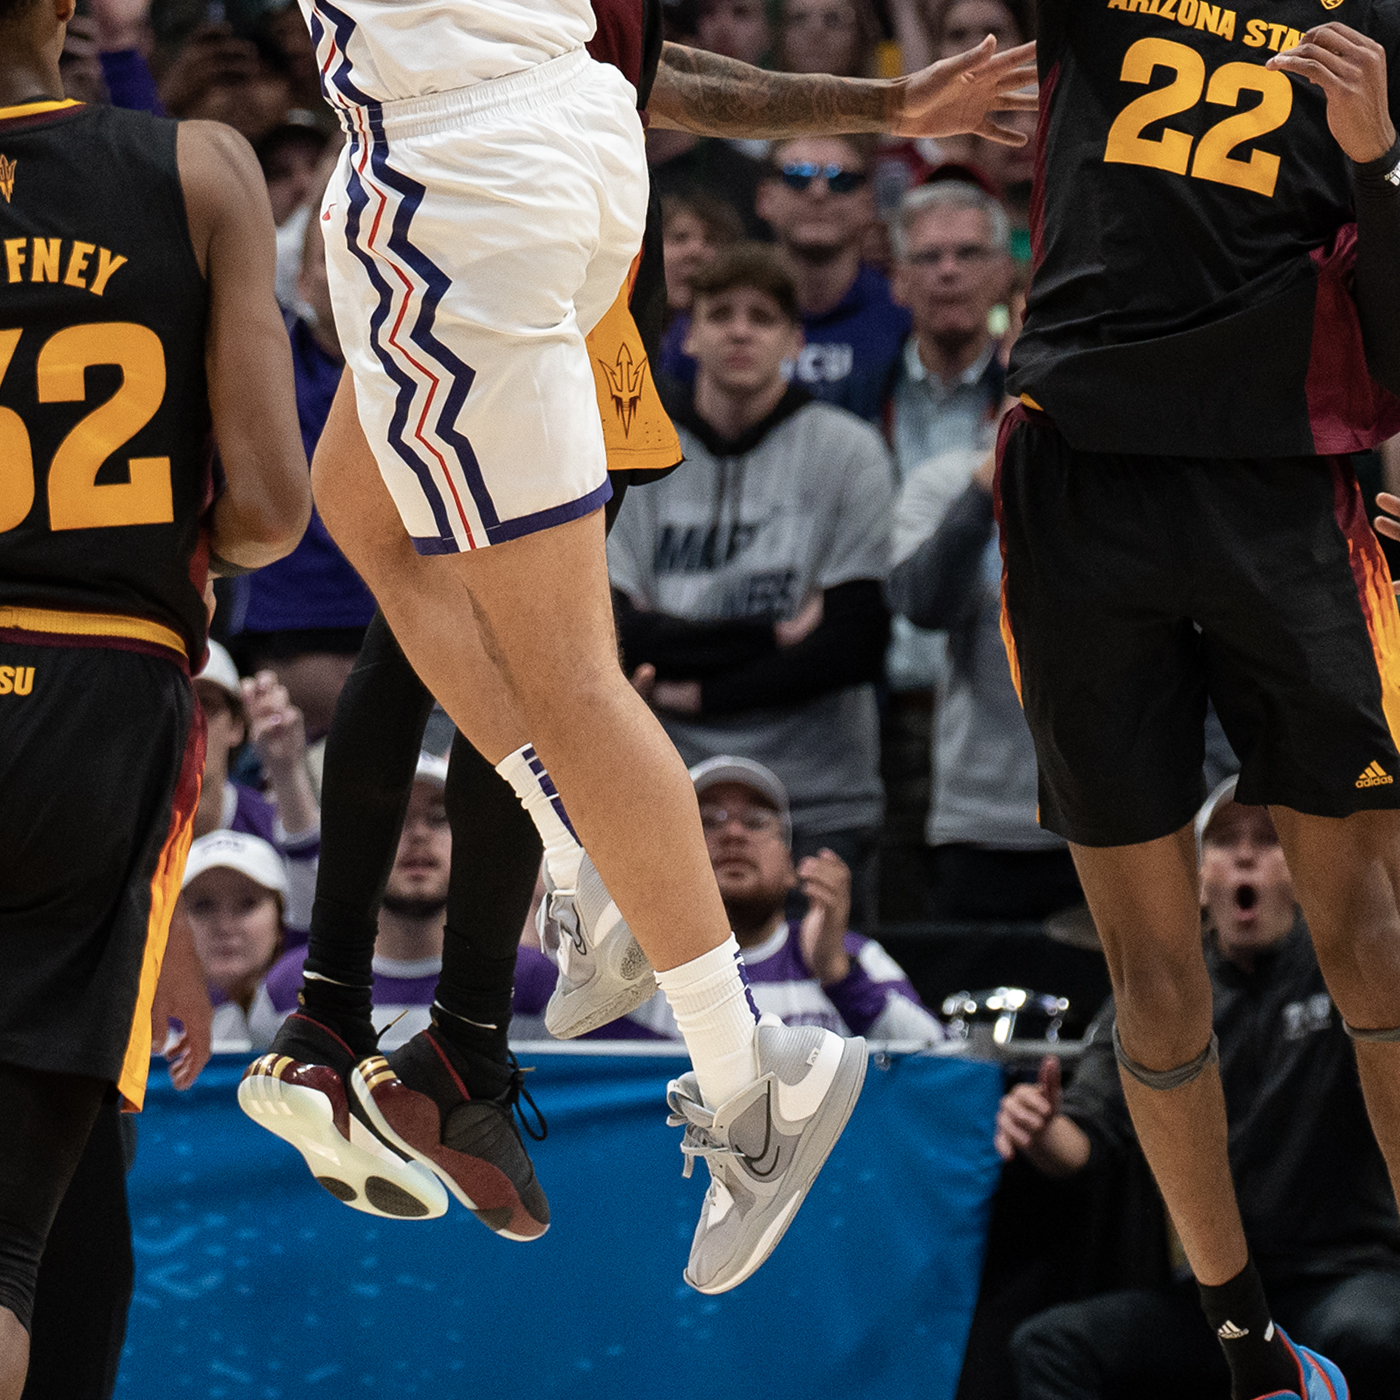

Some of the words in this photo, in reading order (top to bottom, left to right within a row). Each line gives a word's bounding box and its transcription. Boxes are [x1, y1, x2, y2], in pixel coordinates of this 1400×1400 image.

[1242, 18, 1306, 53] STA
[1103, 37, 1294, 198] 22
[1355, 775, 1394, 788] adidas
